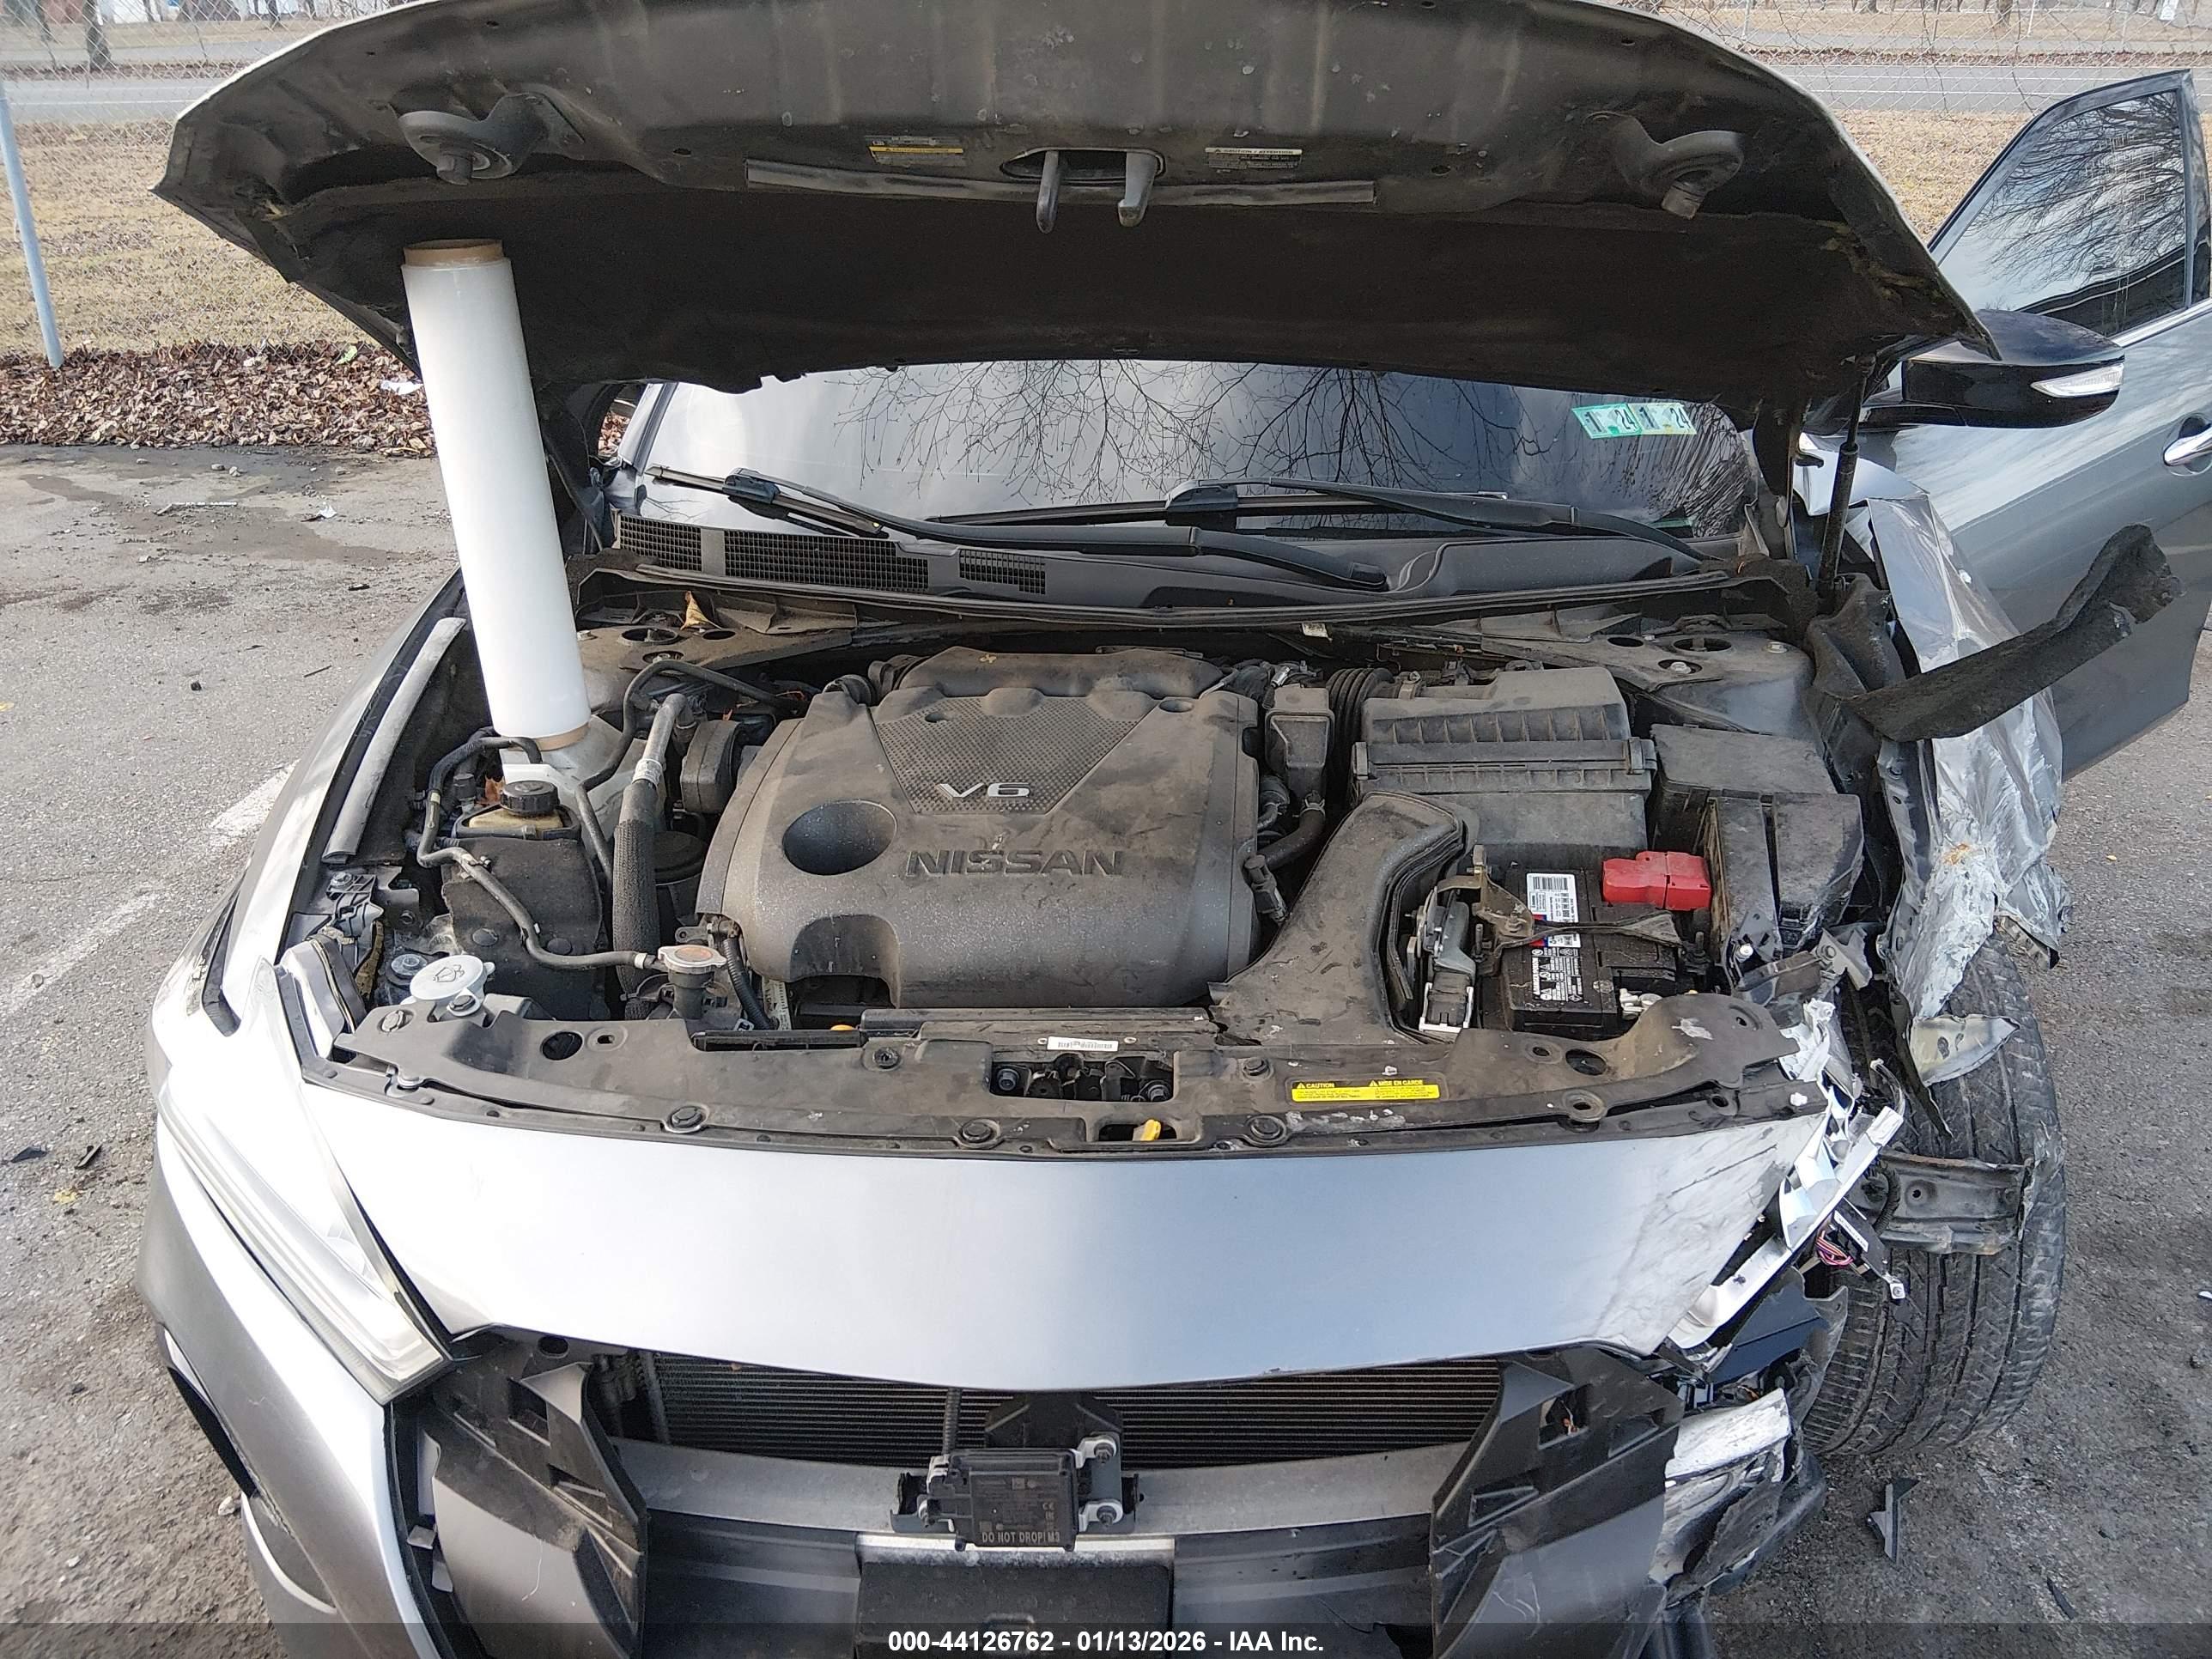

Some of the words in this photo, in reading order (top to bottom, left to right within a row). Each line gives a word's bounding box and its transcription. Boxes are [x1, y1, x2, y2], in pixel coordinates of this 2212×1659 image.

[1583, 411, 1602, 432] 1
[1614, 409, 1638, 430] 24
[1639, 406, 1656, 428] 1
[1670, 407, 1692, 429] 24
[934, 781, 1031, 799] V6
[905, 849, 1124, 878] NISSAN
[982, 1531, 995, 1543] DO
[998, 1531, 1016, 1543] NOT
[1048, 1531, 1060, 1543] M3
